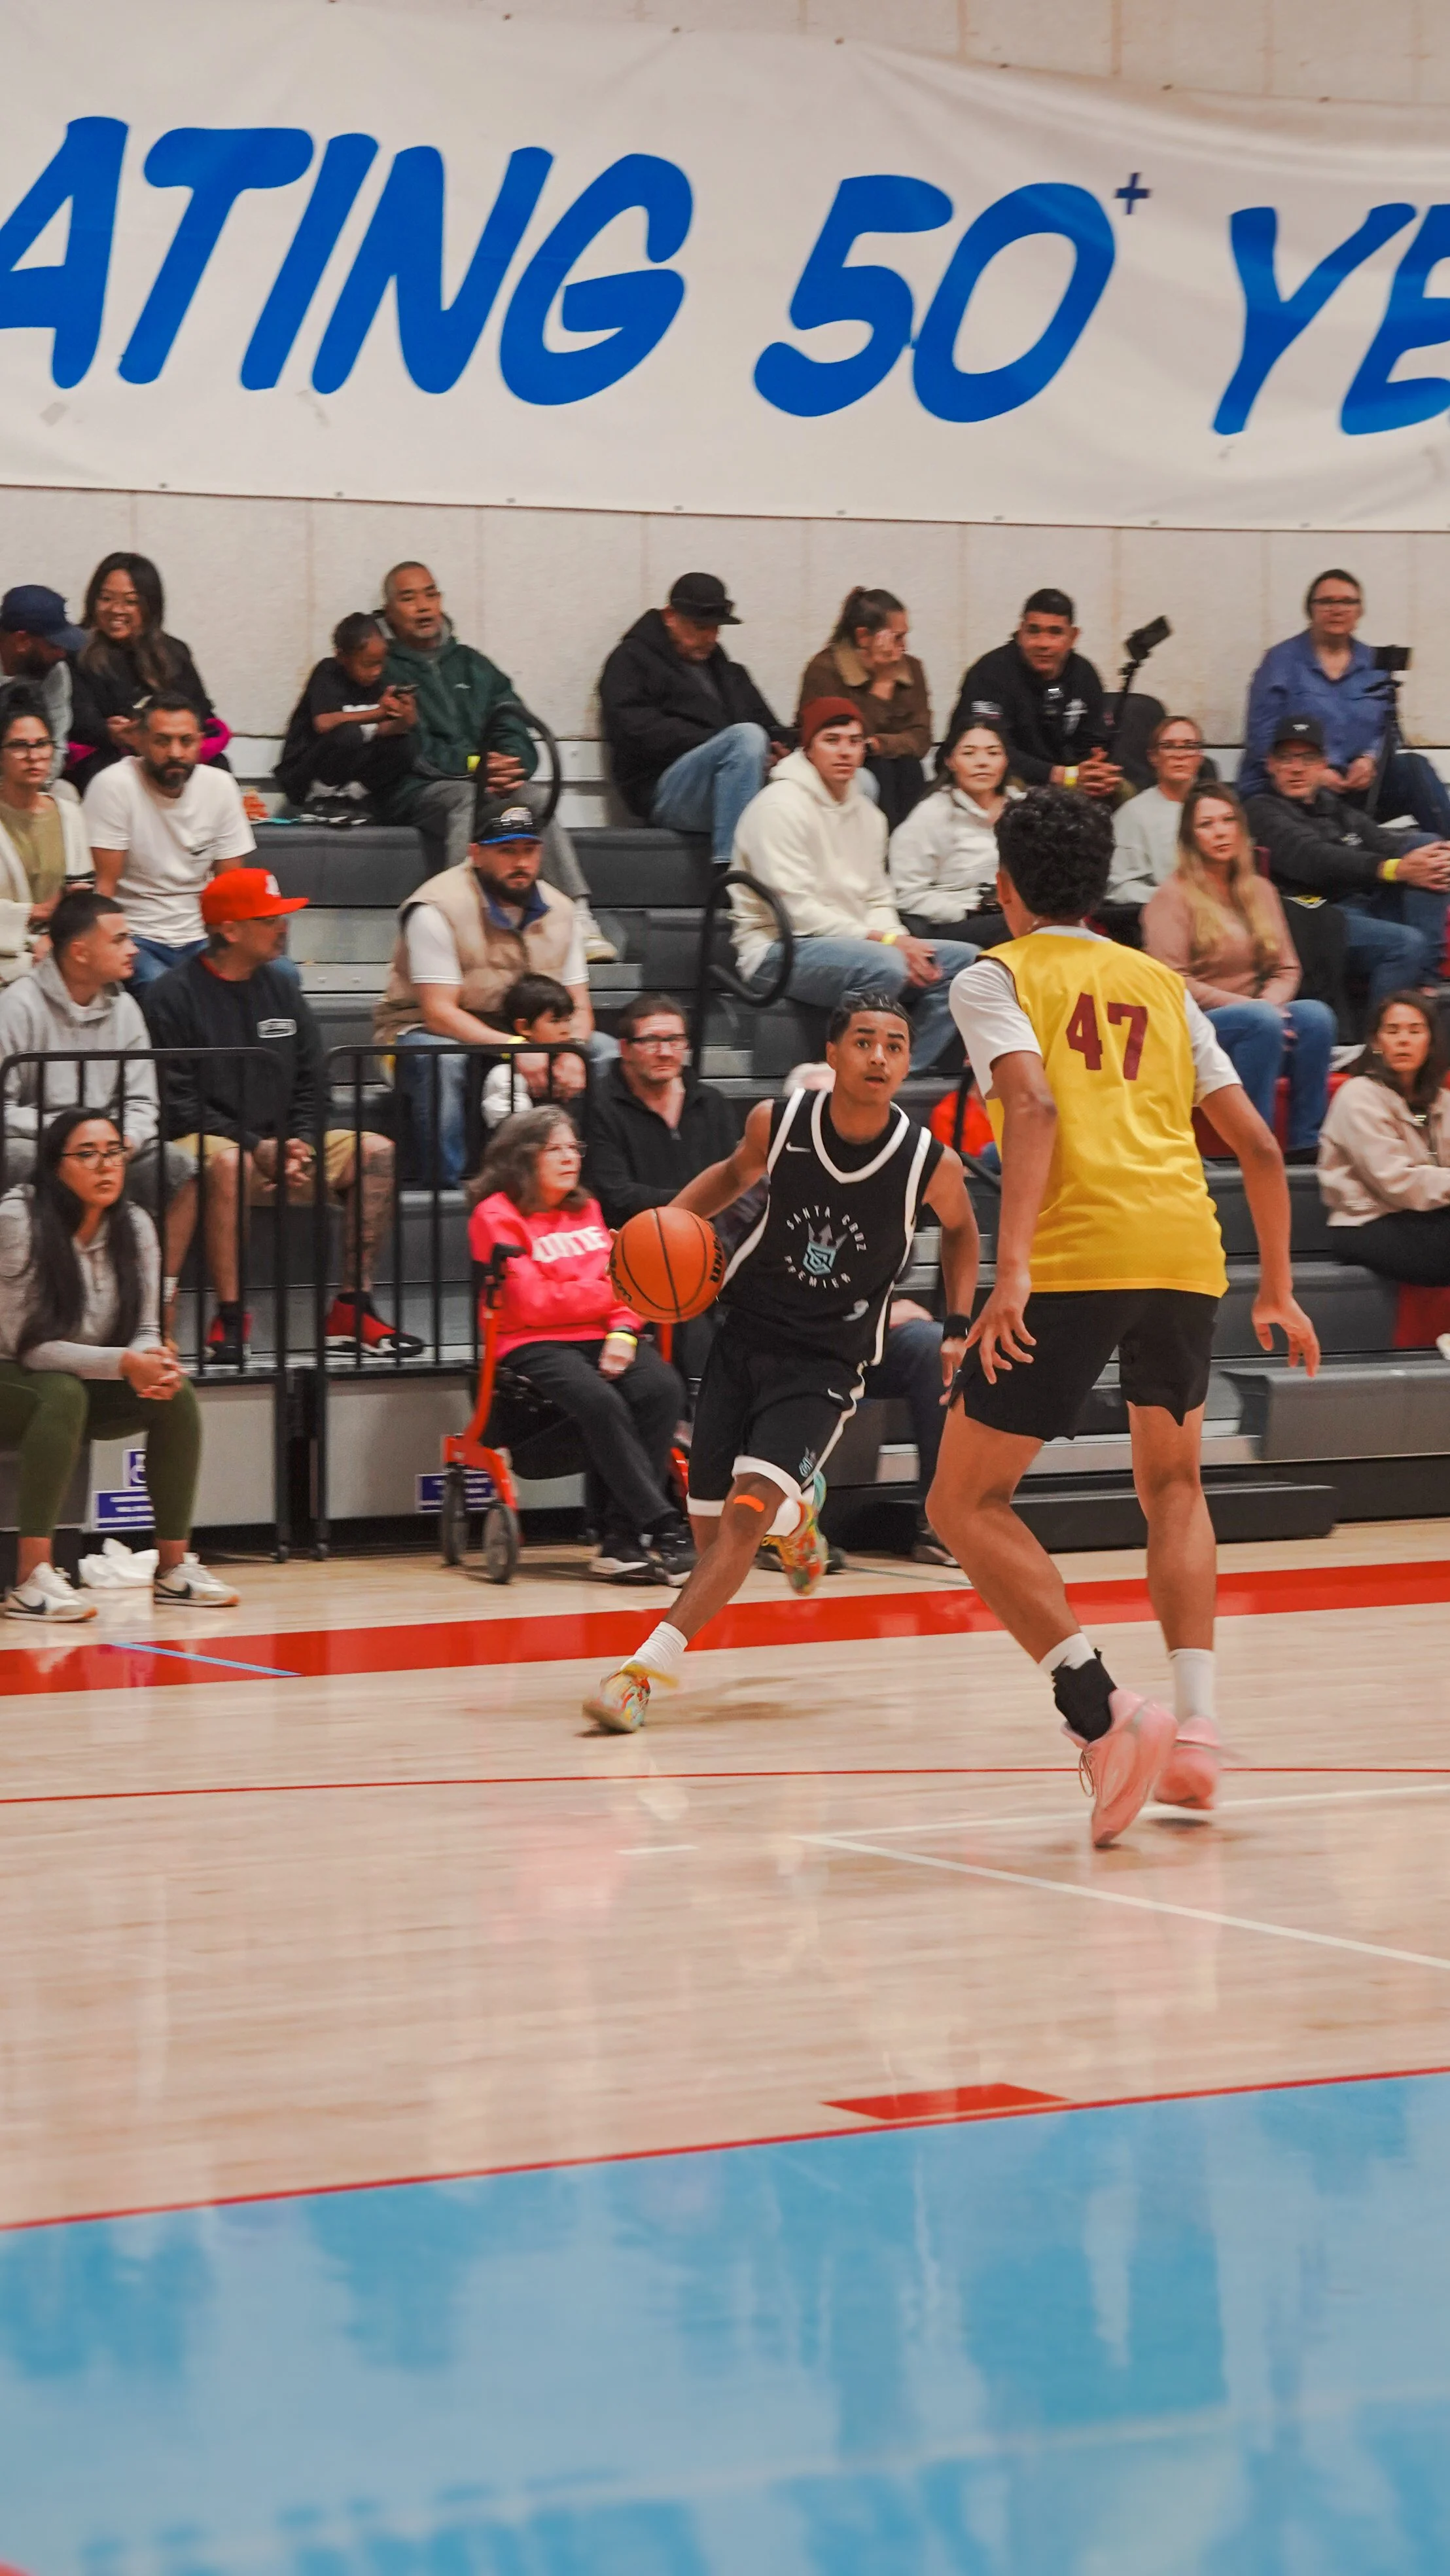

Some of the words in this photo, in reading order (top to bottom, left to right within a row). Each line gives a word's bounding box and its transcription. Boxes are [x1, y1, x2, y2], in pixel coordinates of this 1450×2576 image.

[0, 116, 694, 406] ATING
[1066, 992, 1148, 1081] 47
[786, 1205, 831, 1230] SANTA
[841, 1214, 867, 1251] CRUZ
[785, 1255, 851, 1289] PREMIER
